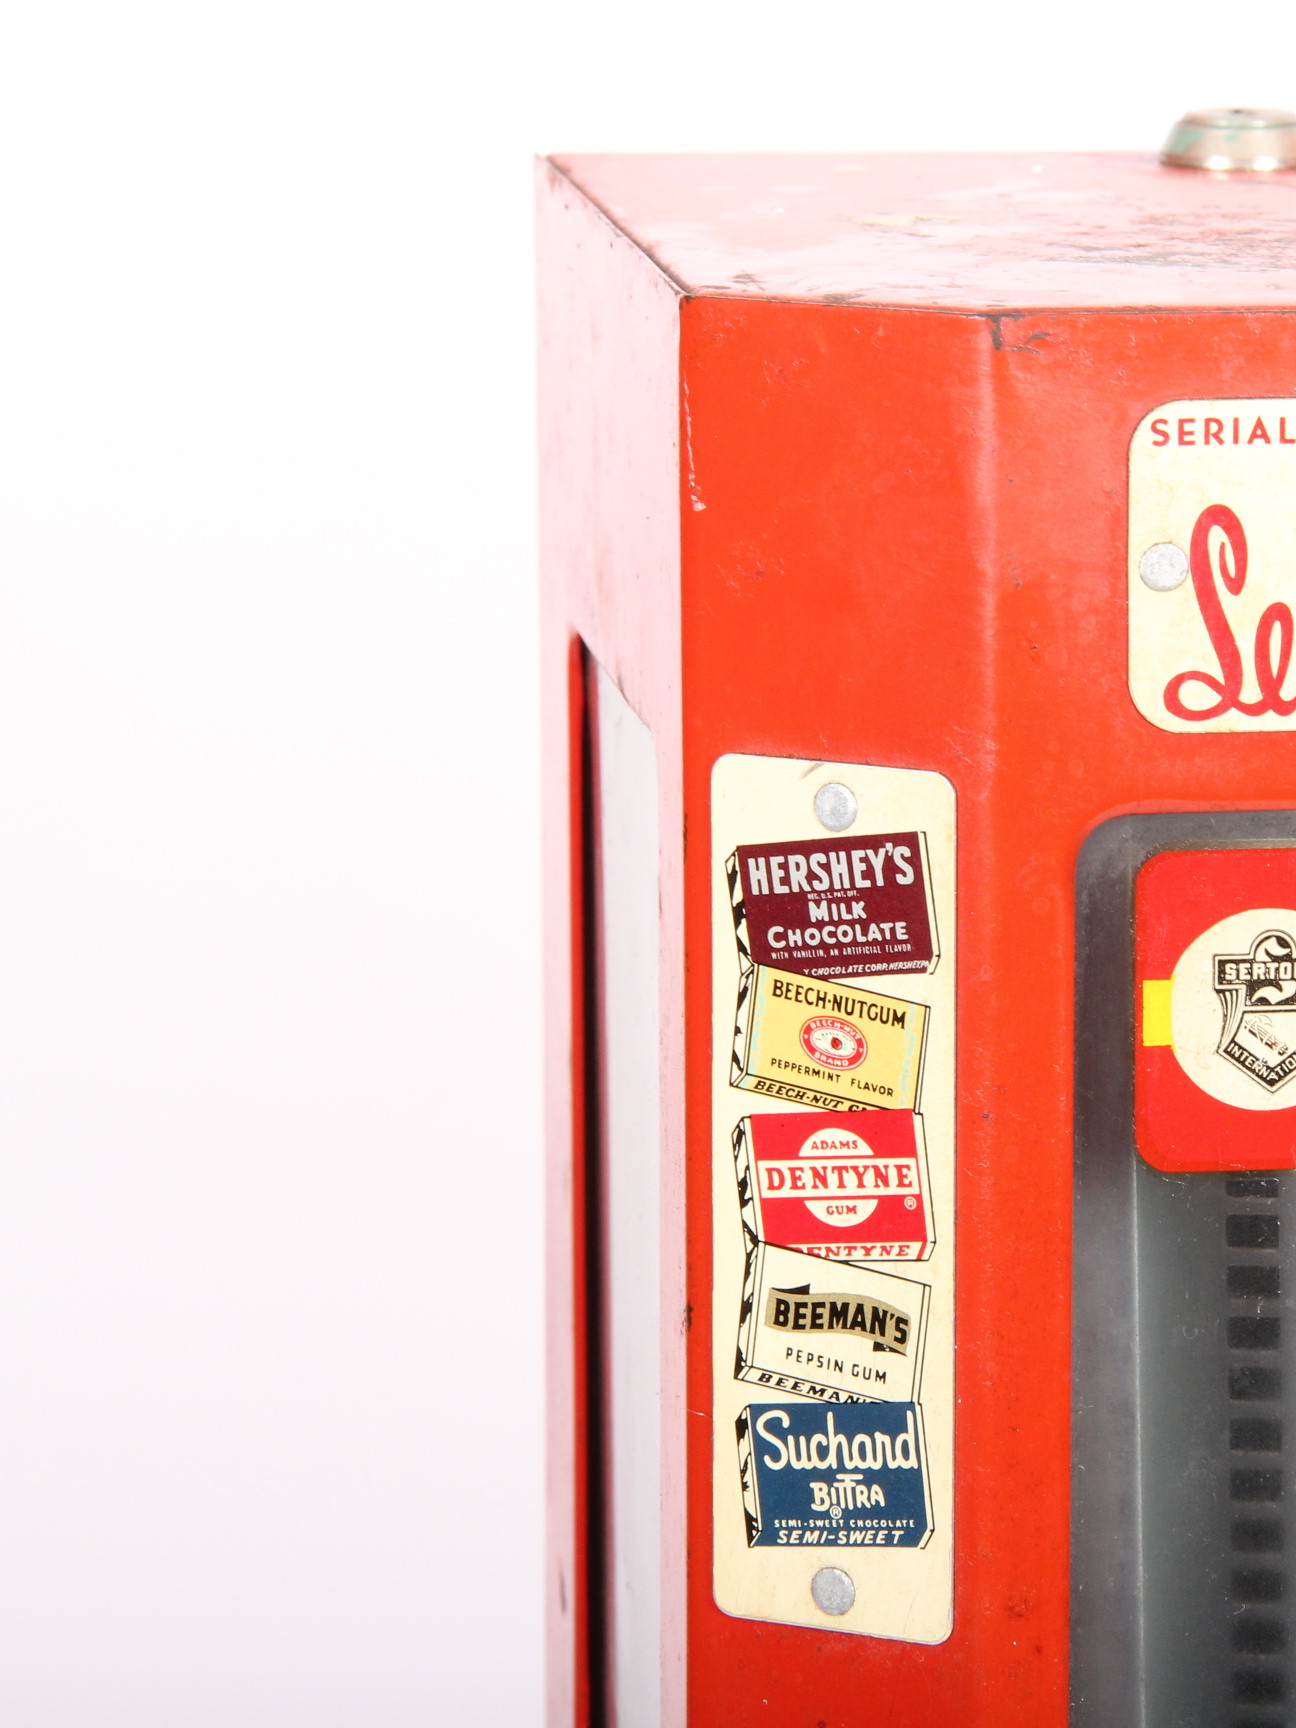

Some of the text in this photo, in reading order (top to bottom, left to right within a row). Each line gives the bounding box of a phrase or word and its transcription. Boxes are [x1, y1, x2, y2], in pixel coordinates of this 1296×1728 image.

[1150, 416, 1296, 446] SERIAL
[747, 842, 914, 896] HERSHEY'S
[808, 900, 867, 923] MILK
[767, 921, 909, 949] CHOCOLATE
[811, 964, 864, 977] CHOCOLATE
[814, 1051, 849, 1067] BRAND
[770, 1058, 894, 1098] PEPPERMINT FLAVOR
[754, 1079, 843, 1109] BEECH-NUT
[810, 1139, 860, 1151] ADAMS
[764, 1164, 913, 1191] DENTYNE
[826, 1205, 858, 1216] GUM
[773, 1298, 909, 1345] BEEMAN'S
[785, 1347, 888, 1385] PEPSIN GUM
[756, 1409, 918, 1471] Suchard
[774, 1519, 915, 1528] SEMI-SWEET CHOCOLATE
[776, 1530, 905, 1545] SEMI-SWEET
